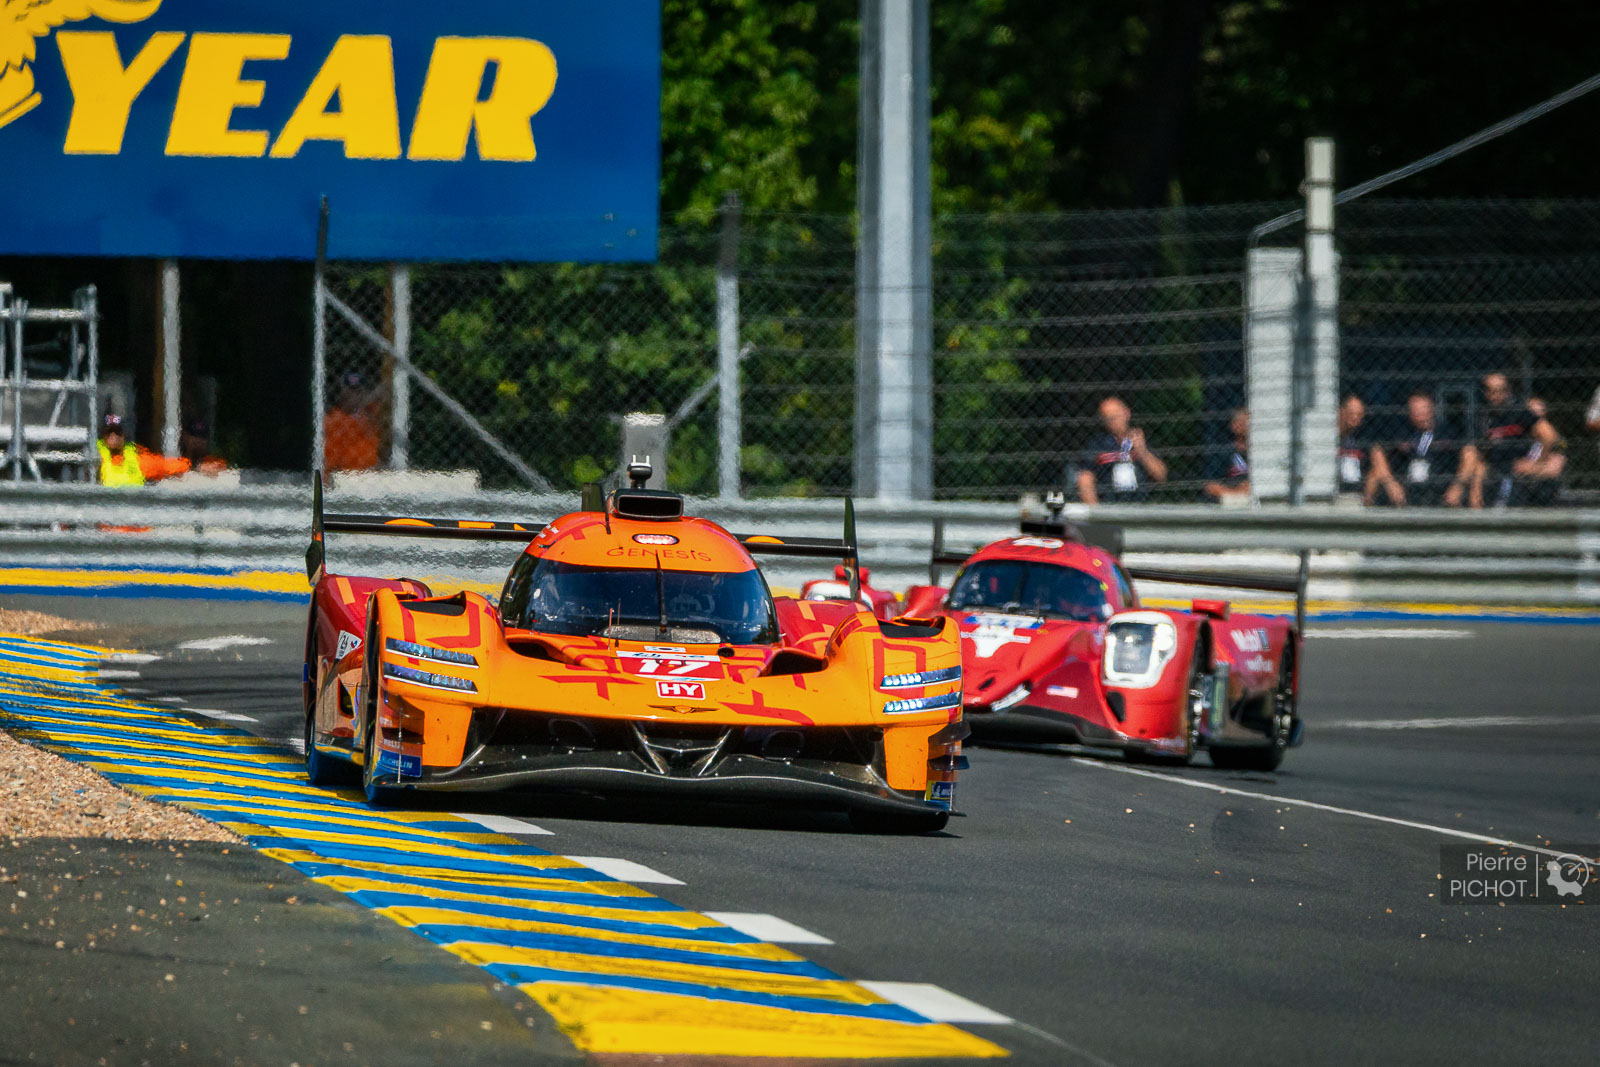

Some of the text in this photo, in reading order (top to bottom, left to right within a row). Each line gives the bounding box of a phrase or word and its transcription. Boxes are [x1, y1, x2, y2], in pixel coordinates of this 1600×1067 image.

[56, 31, 558, 162] YEAR
[607, 547, 712, 562] GENESIS
[638, 659, 710, 674] 17
[661, 683, 700, 696] HY
